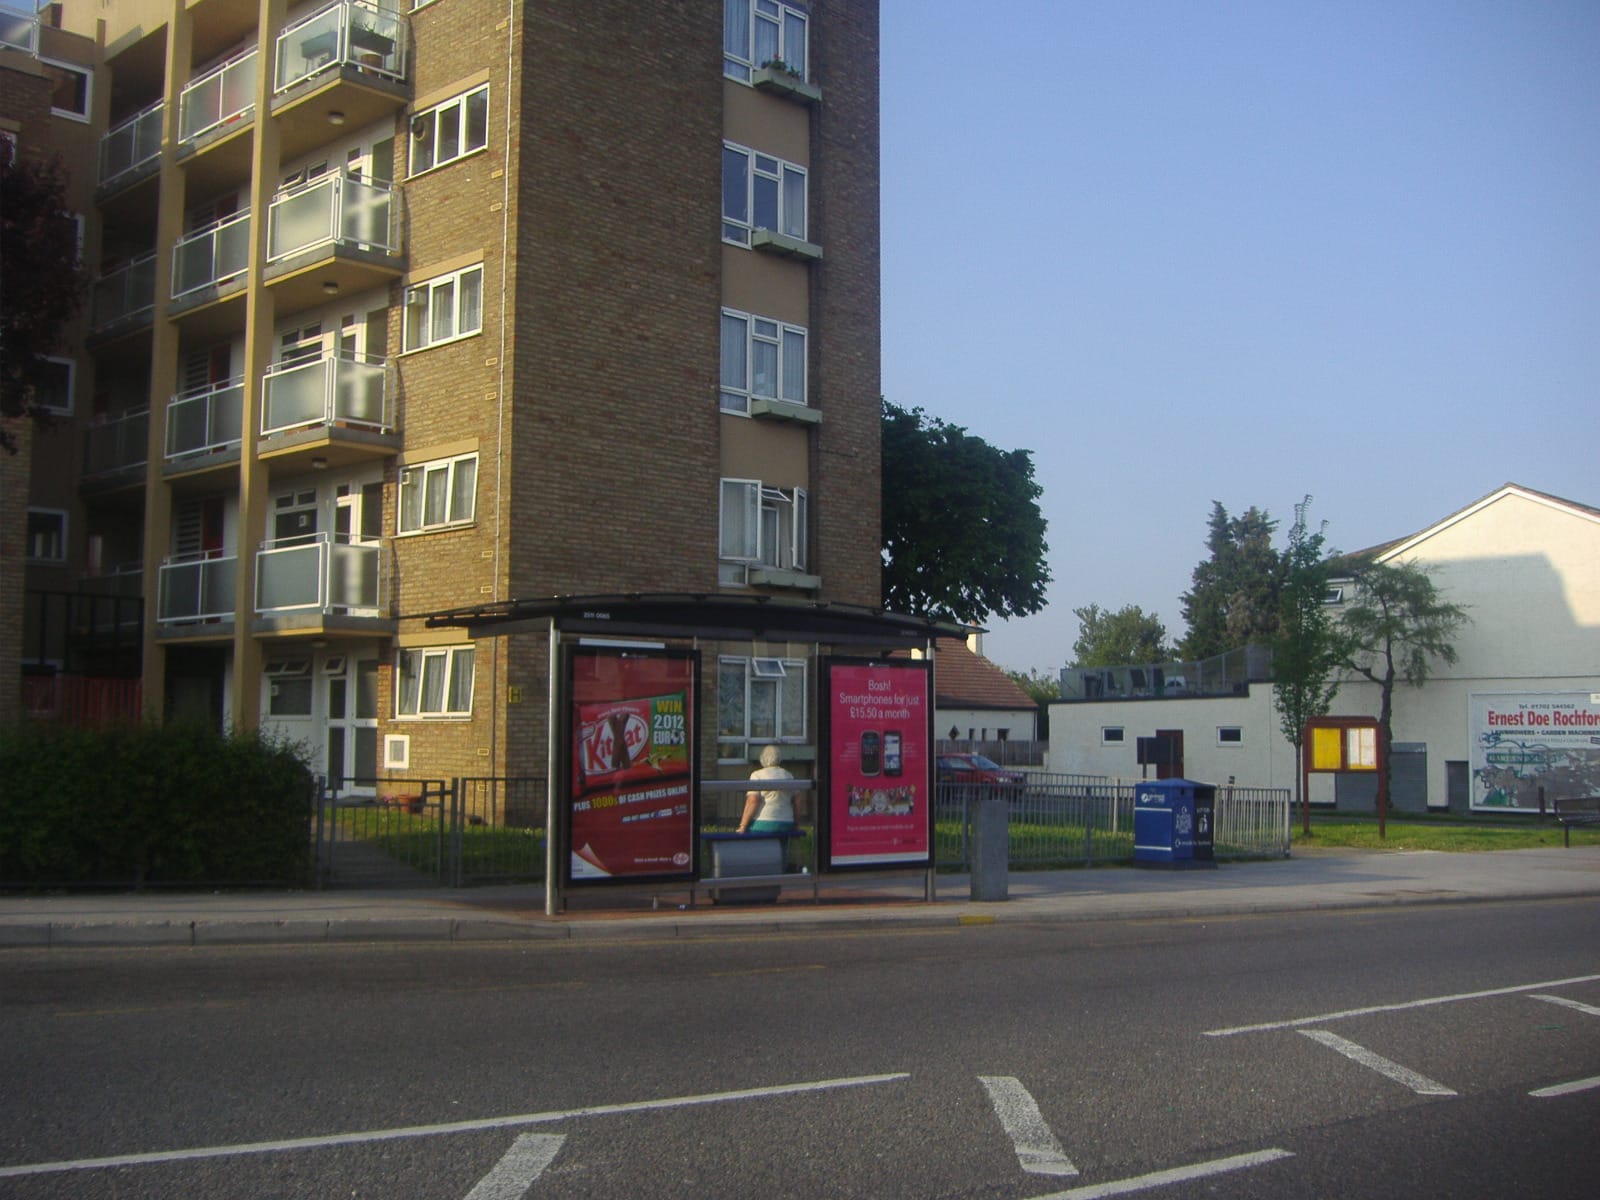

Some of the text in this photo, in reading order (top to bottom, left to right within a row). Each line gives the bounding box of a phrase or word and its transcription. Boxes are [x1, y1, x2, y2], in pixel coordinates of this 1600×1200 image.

[868, 680, 891, 691] Bosh!
[657, 700, 683, 713] WIN
[840, 692, 919, 708] Smartphones for just
[885, 707, 910, 719] month
[1488, 710, 1524, 726] Ernest
[1528, 710, 1550, 726] Doe
[573, 800, 591, 812] PLUS
[627, 791, 645, 803] CASH
[645, 788, 666, 800] PRIZES
[667, 785, 688, 796] ONLINE
